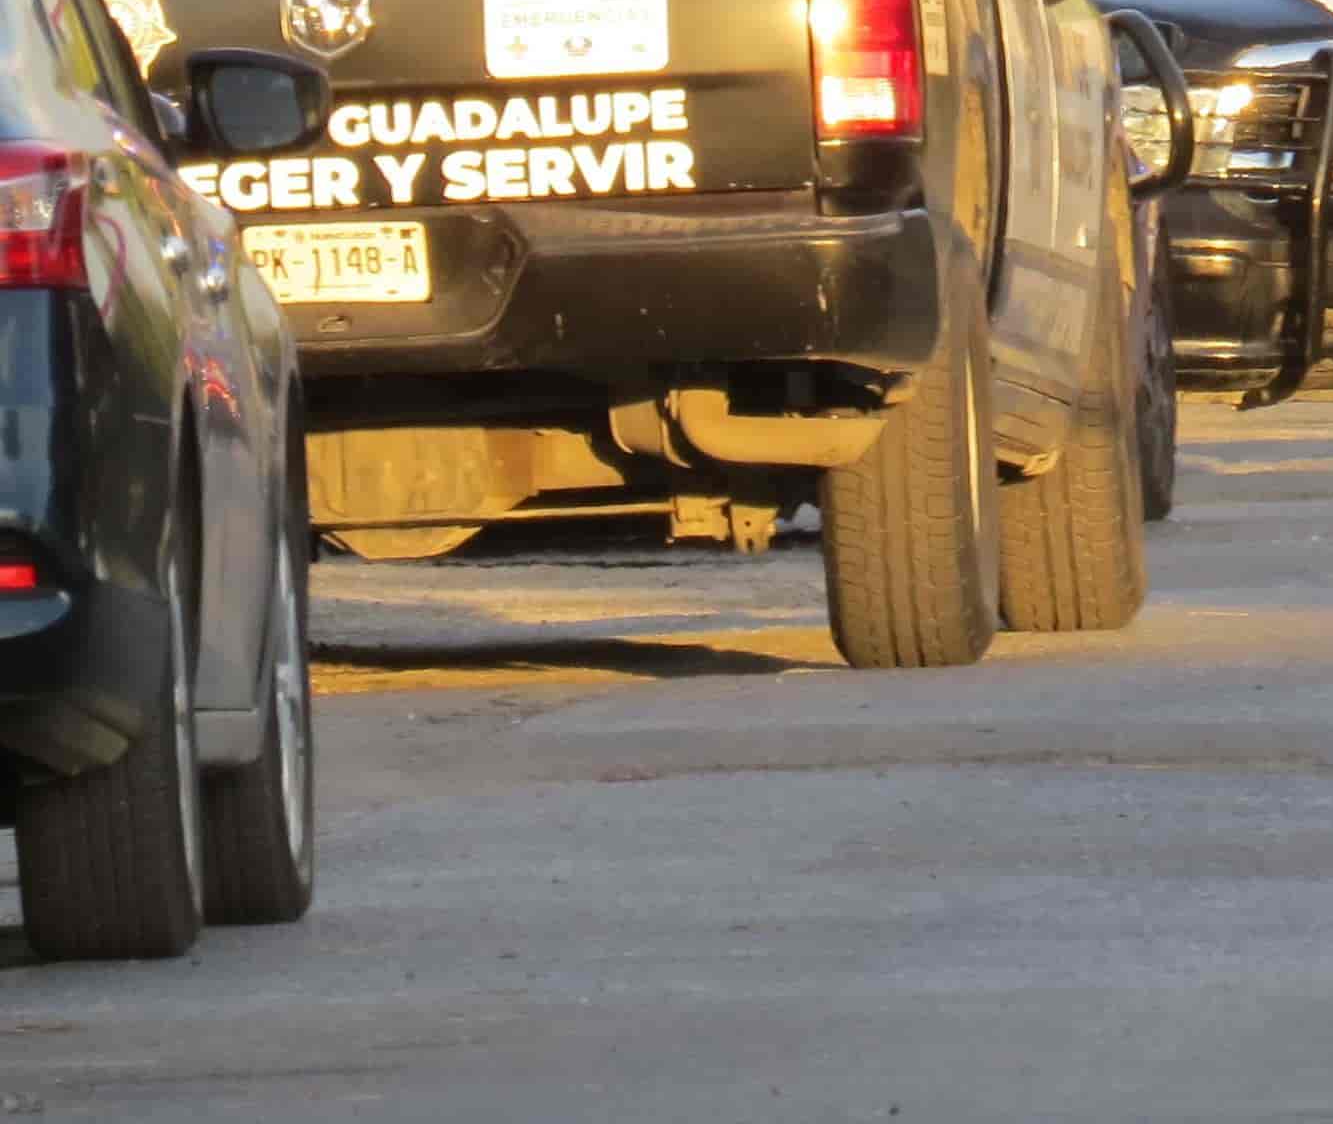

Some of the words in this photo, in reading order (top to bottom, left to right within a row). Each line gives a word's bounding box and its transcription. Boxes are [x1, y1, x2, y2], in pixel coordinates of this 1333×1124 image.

[328, 89, 689, 147] GUADALUPE
[178, 157, 360, 211] EGER
[373, 153, 427, 204] Y
[441, 140, 697, 201] SERVIR
